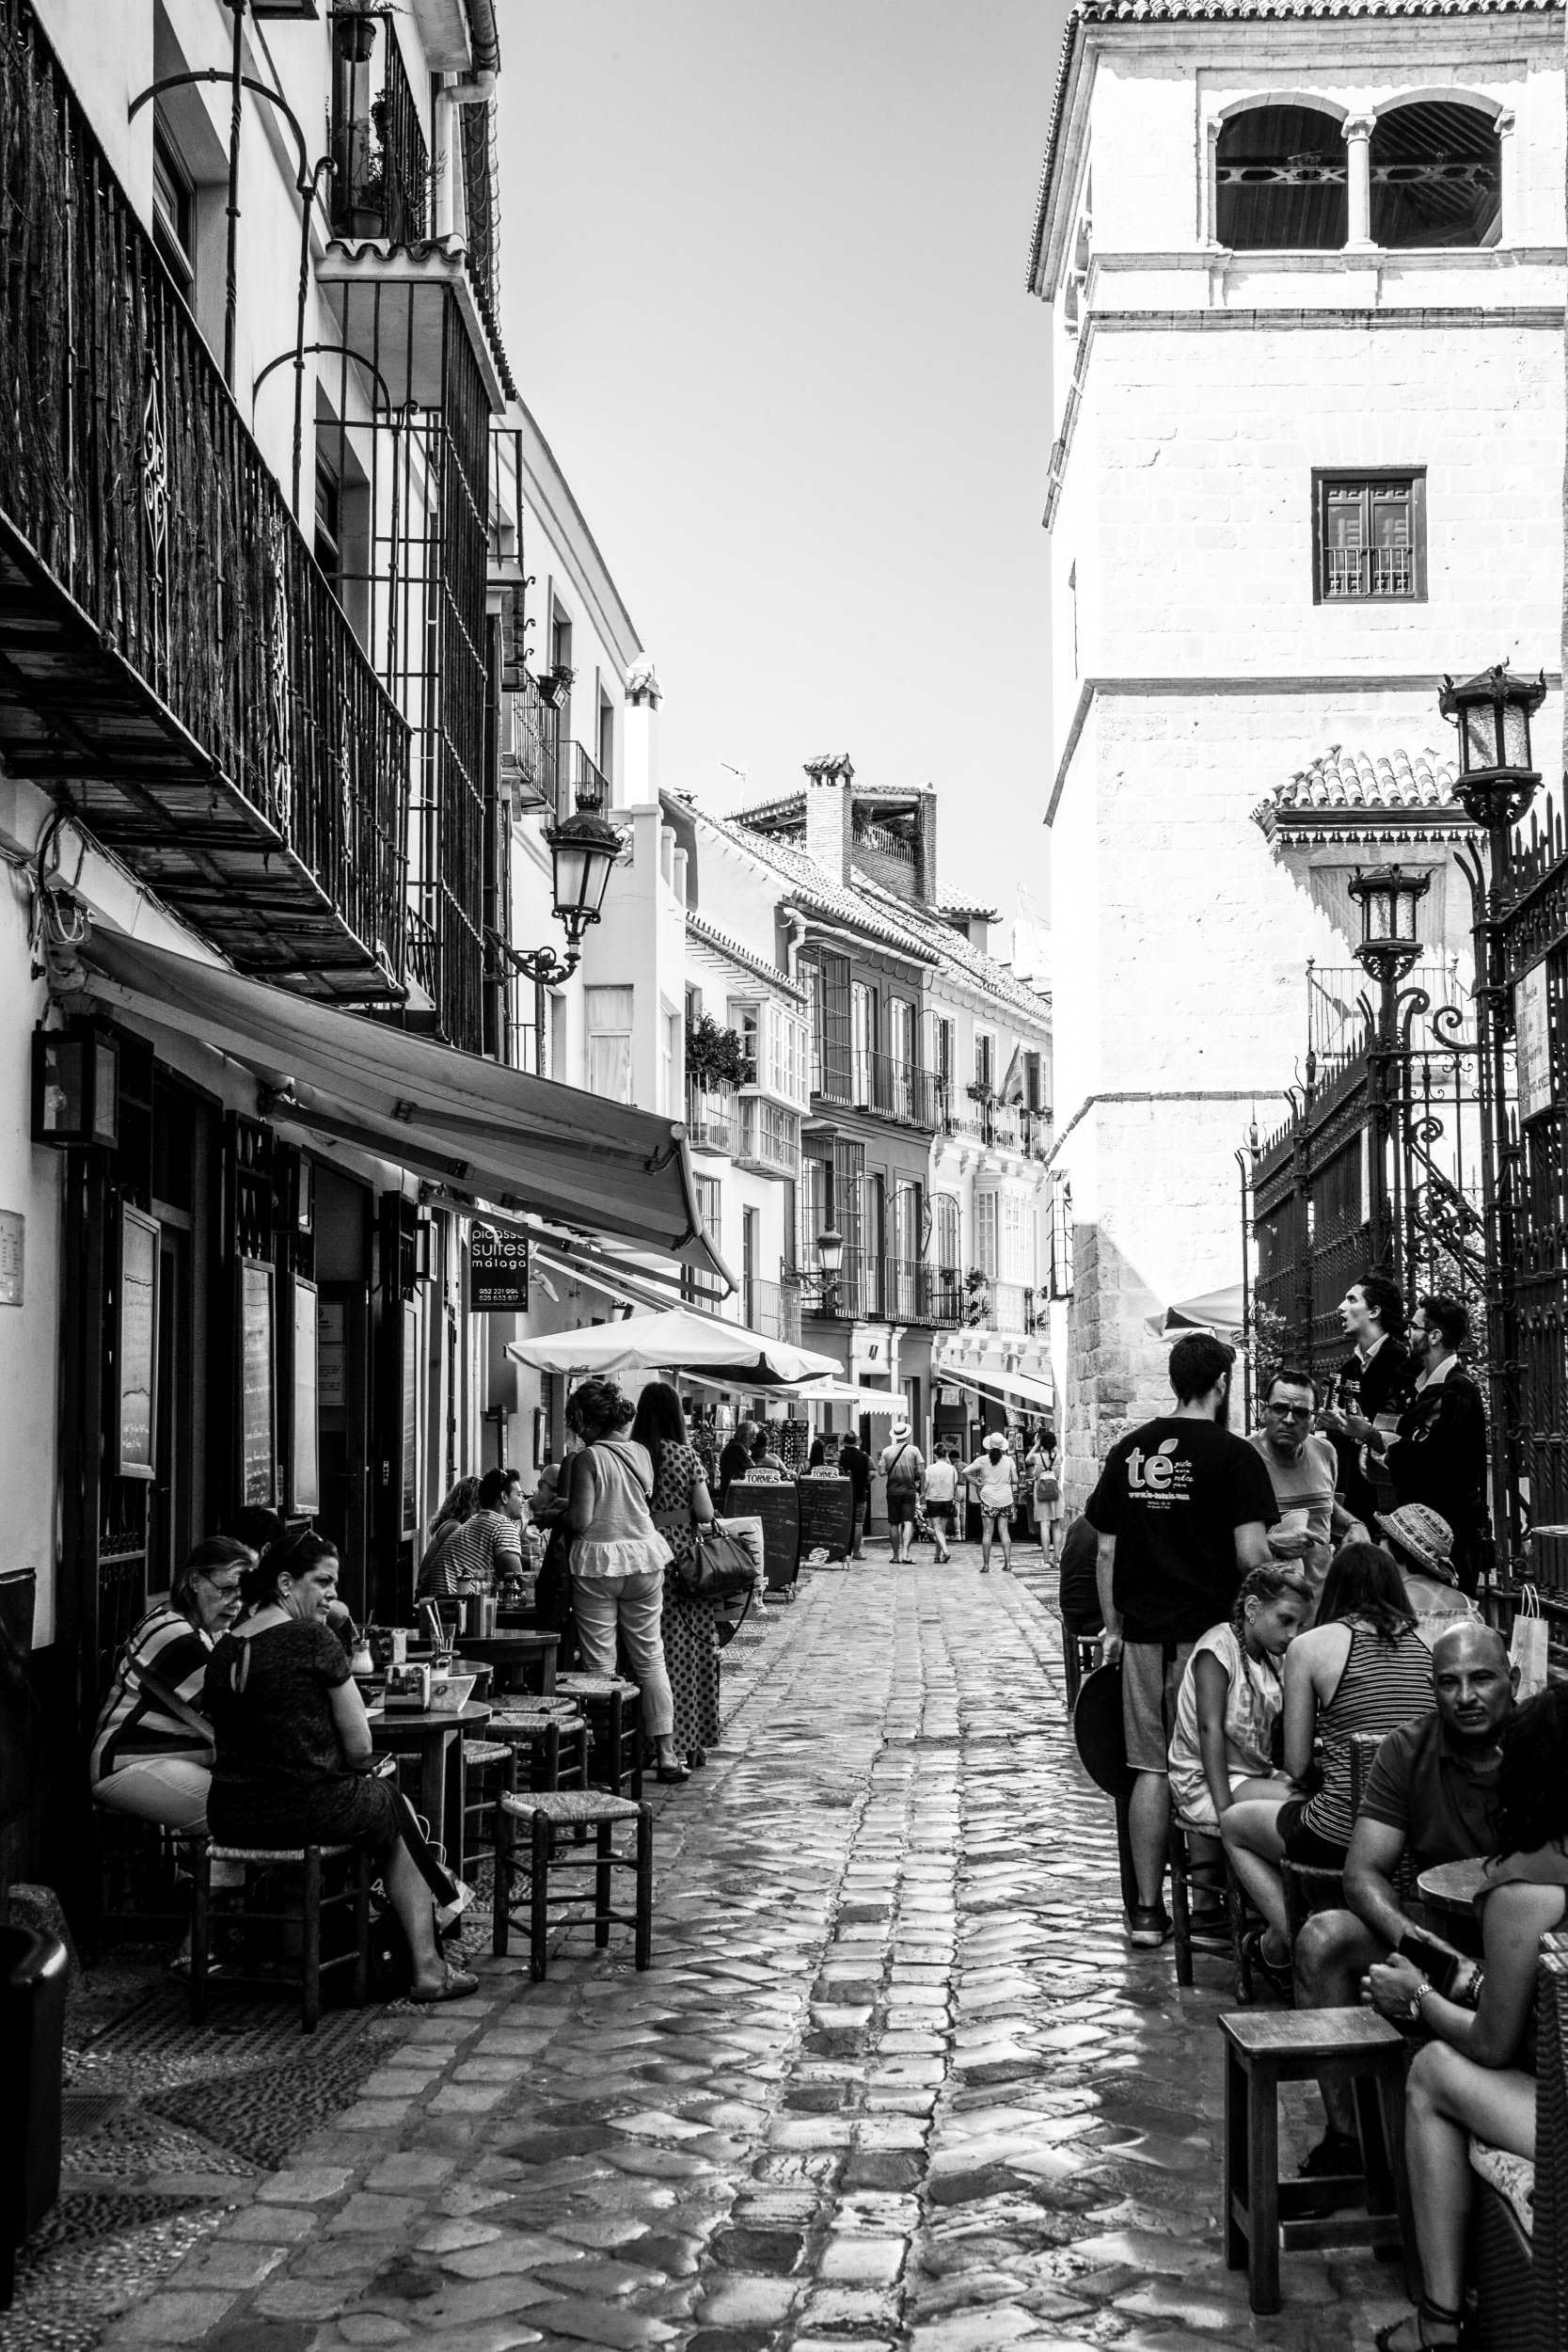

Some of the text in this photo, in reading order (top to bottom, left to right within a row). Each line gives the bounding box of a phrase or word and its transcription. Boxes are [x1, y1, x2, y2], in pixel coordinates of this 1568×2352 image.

[472, 1241, 526, 1256] suites
[472, 1258, 526, 1269] málaga
[1125, 1438, 1179, 1489] té
[747, 1474, 779, 1484] TORMES
